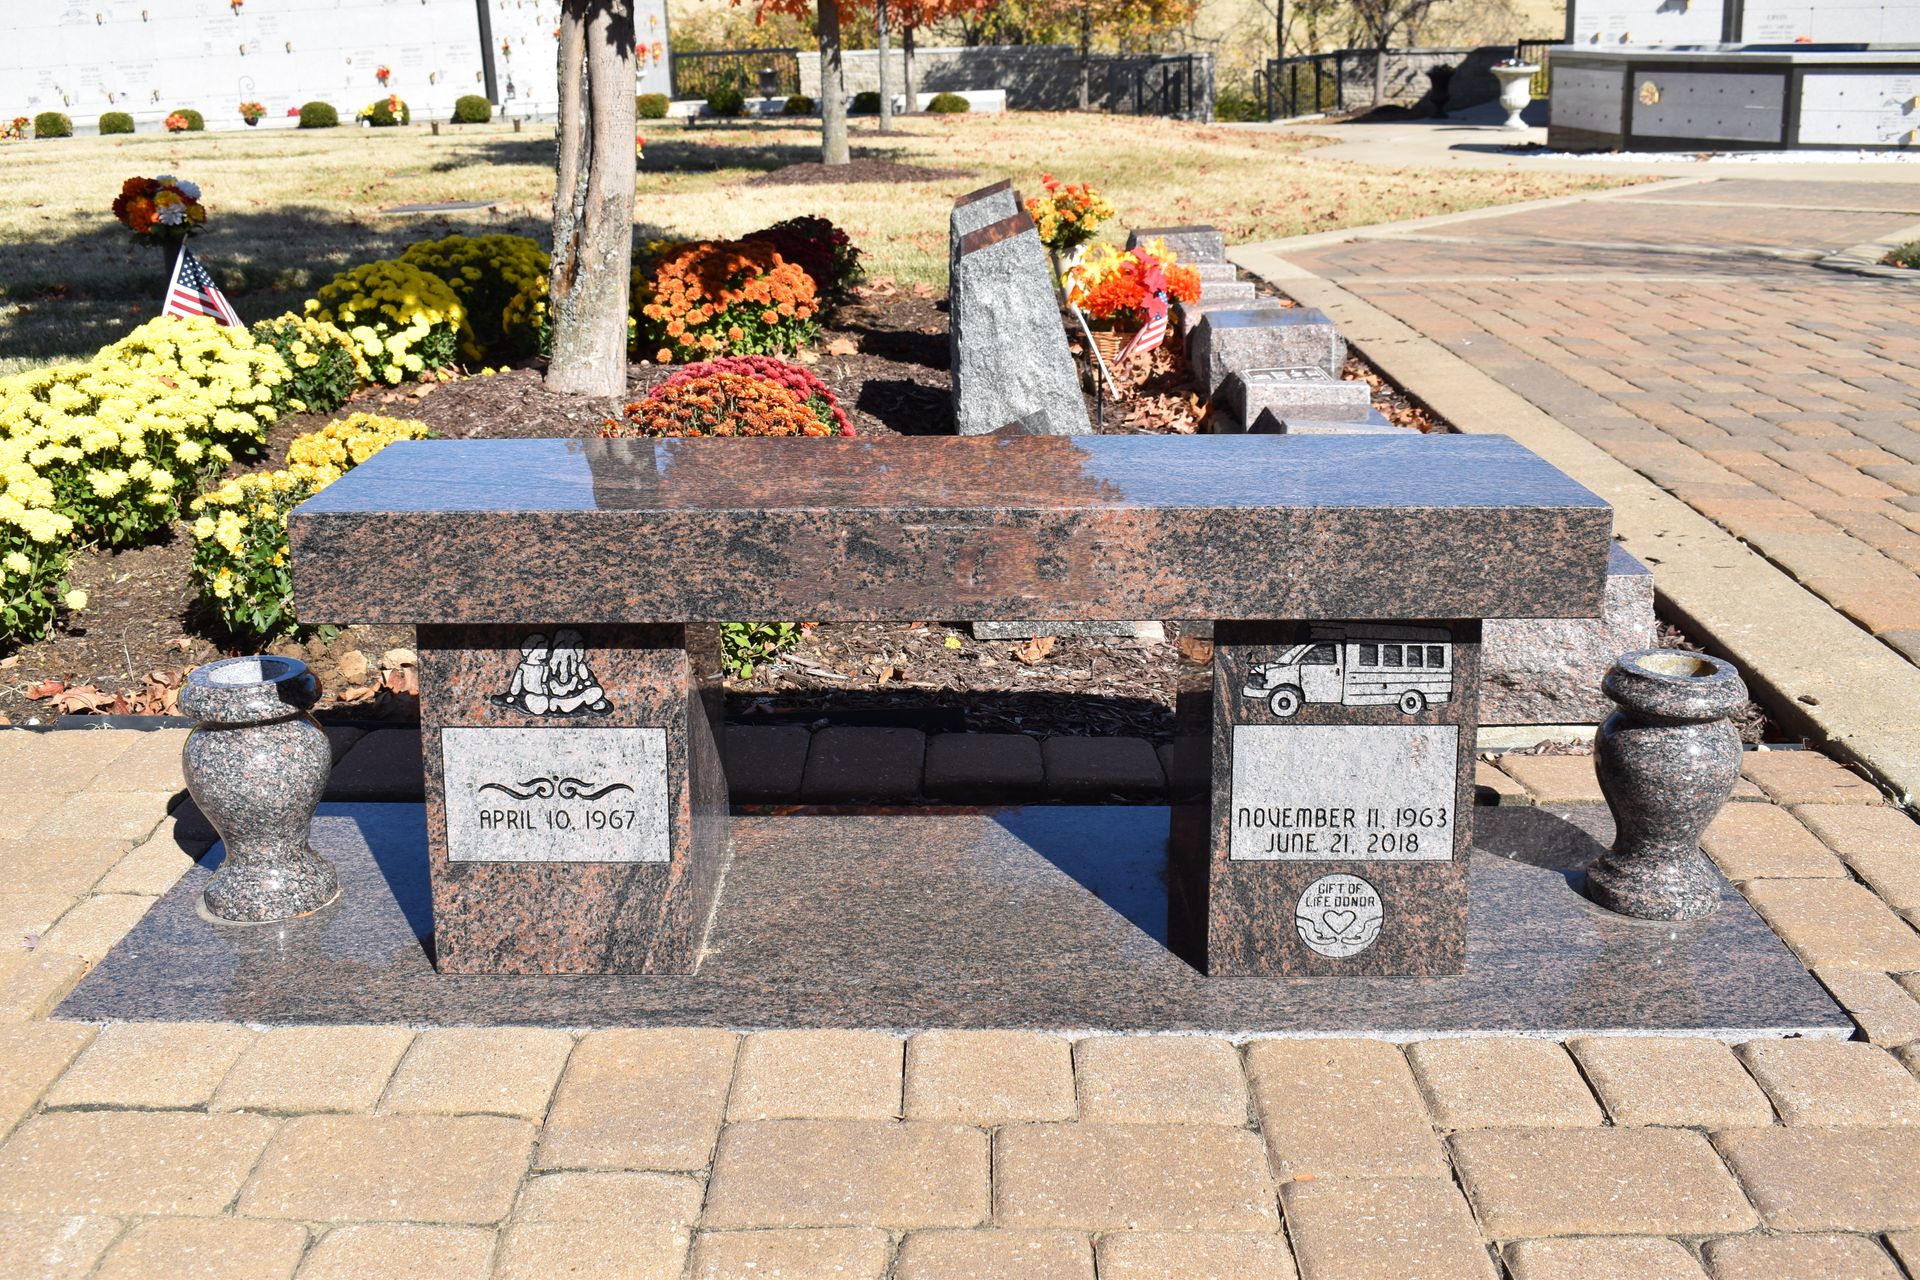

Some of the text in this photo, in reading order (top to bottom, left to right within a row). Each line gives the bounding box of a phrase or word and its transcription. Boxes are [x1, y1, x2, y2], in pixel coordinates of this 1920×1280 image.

[479, 809, 636, 832] APRIL 10, 1967
[1237, 807, 1448, 830] NOVEMBER 11, 1963
[1265, 832, 1420, 855] JUNE 21, 2018
[1317, 883, 1363, 895] GIFT OF
[1305, 896, 1376, 908] LIFE DONOR
